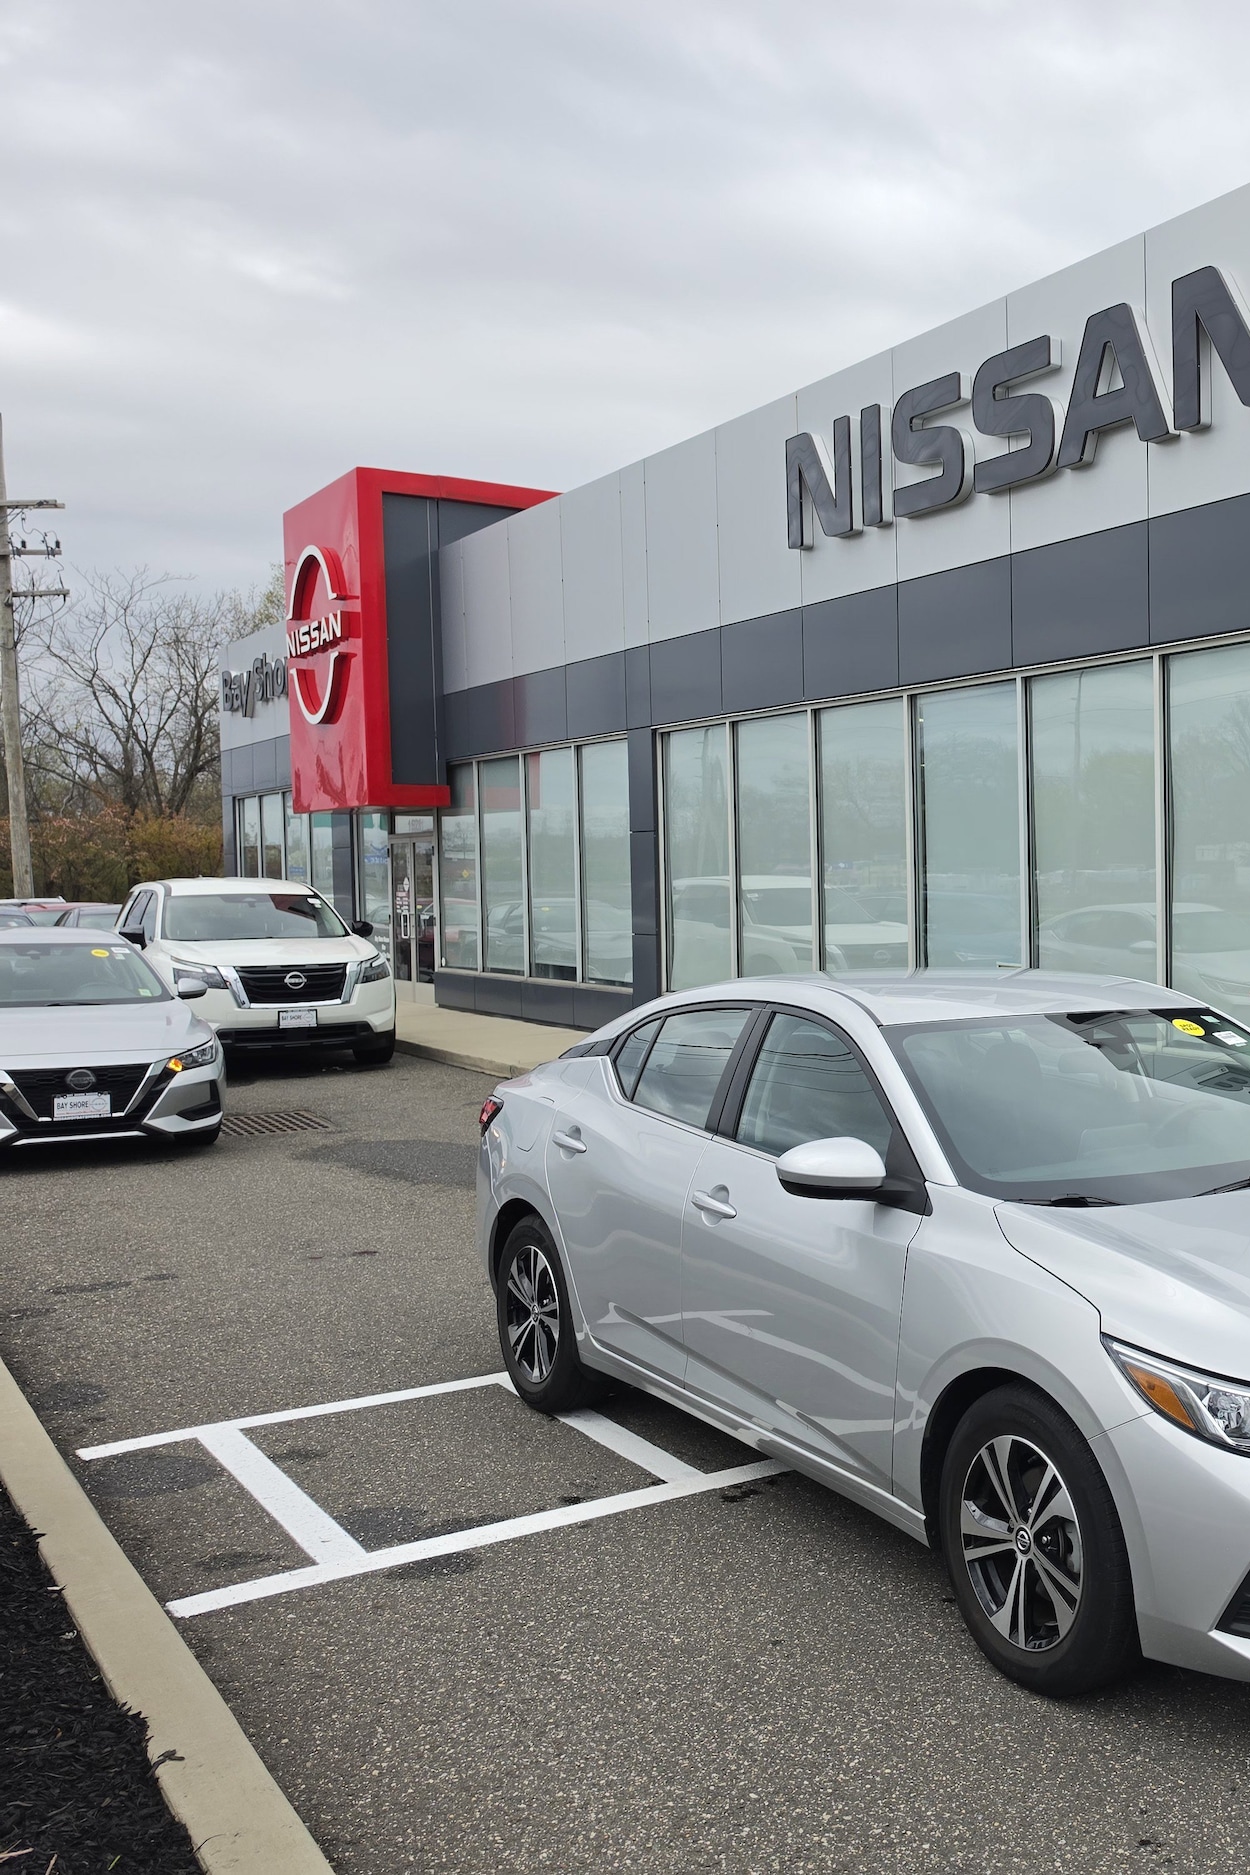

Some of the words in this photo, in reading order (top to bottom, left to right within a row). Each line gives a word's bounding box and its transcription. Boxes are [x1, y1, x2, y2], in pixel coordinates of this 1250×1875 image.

[286, 610, 341, 658] NISSAN
[221, 669, 255, 718] Bay
[56, 1102, 68, 1110] BAY
[69, 1100, 89, 1109] SHORE
